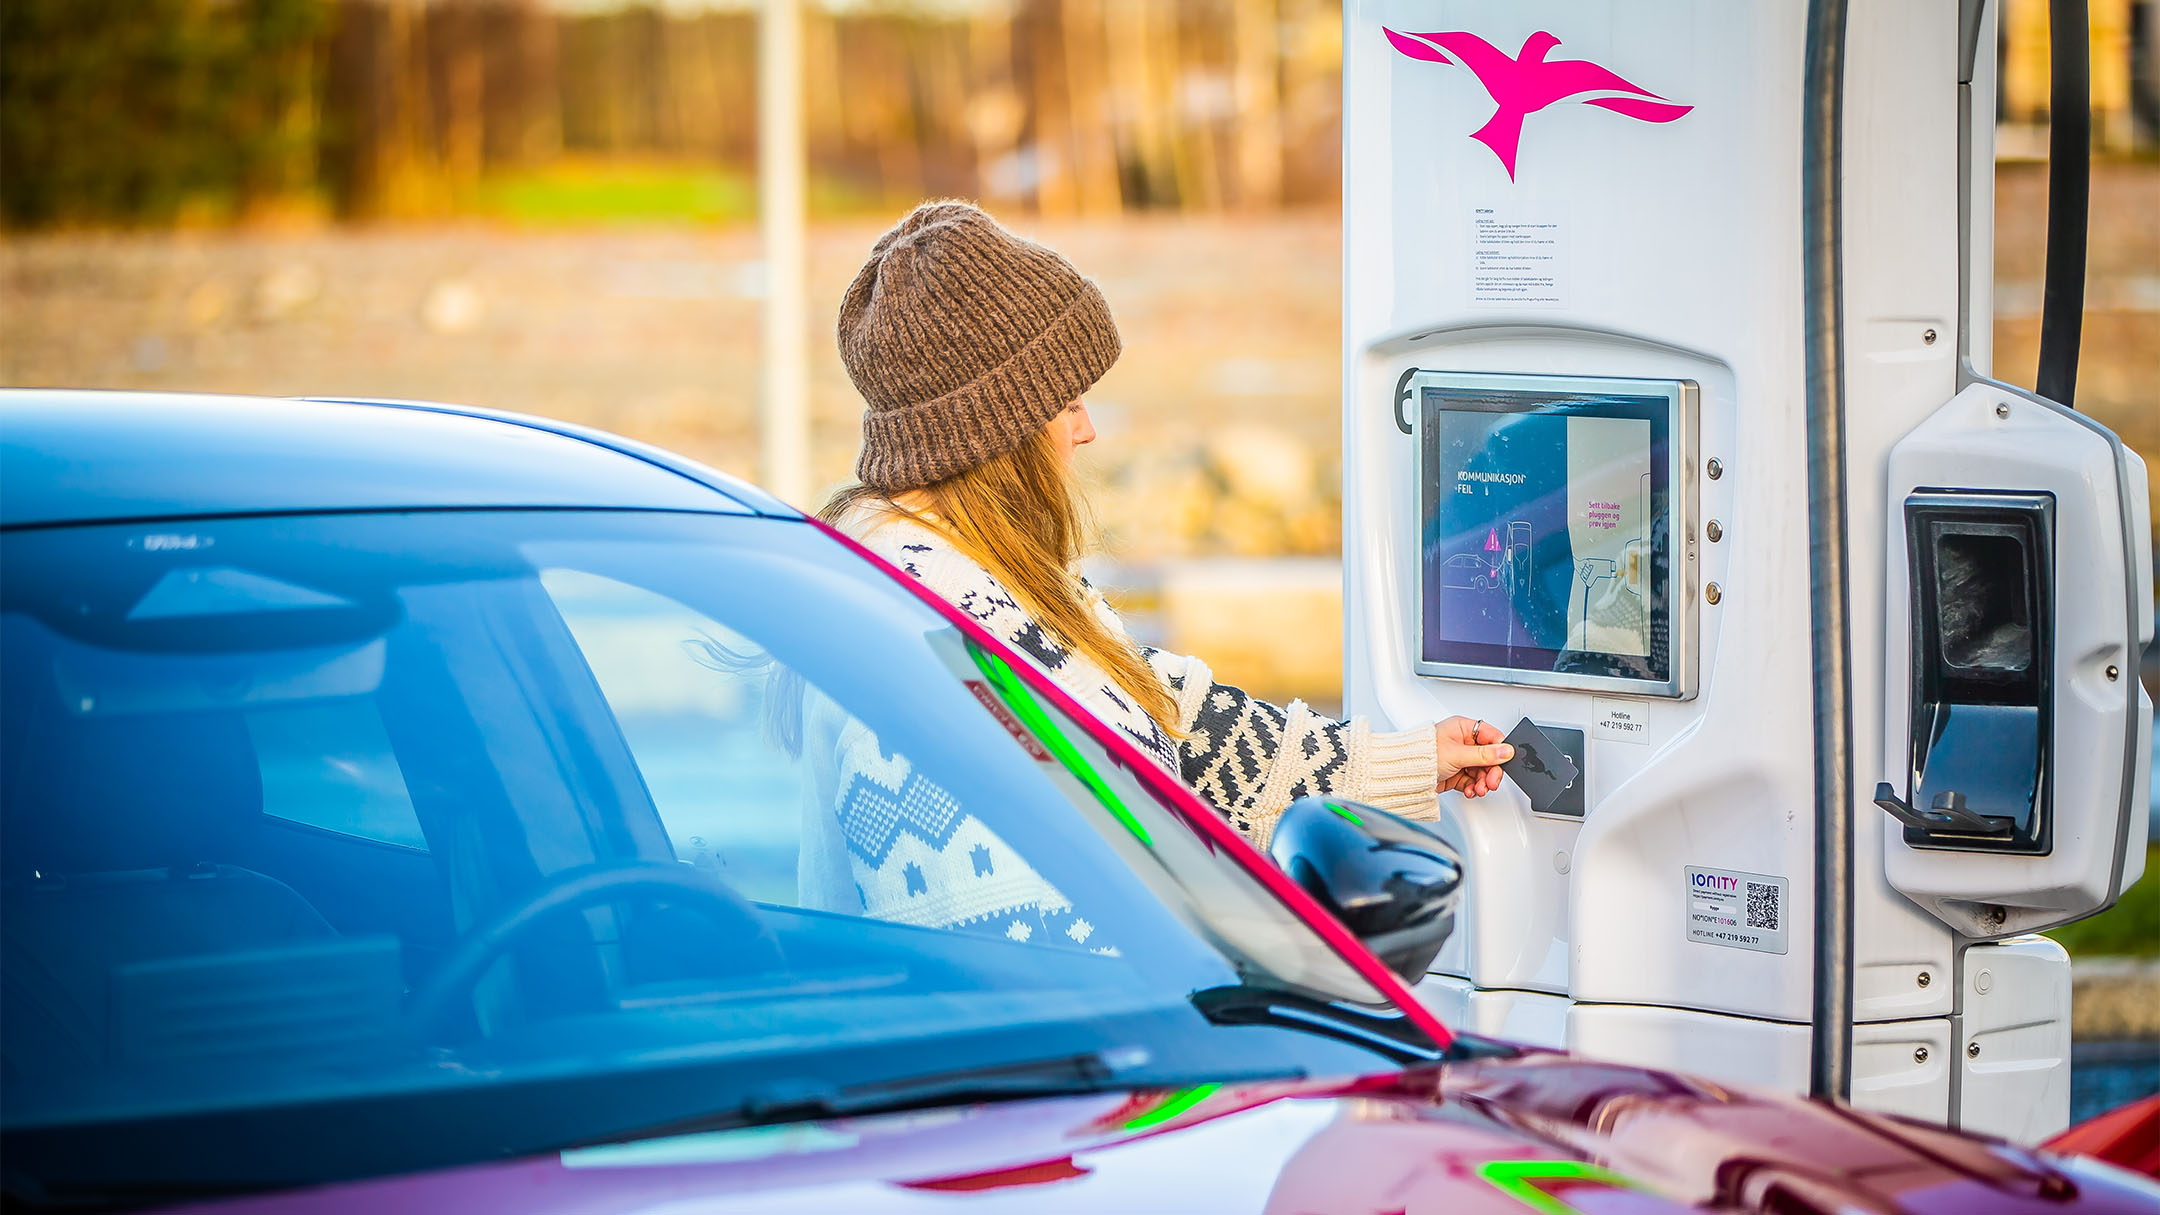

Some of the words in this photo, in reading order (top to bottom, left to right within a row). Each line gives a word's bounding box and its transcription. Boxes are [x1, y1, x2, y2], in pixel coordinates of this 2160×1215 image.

[1457, 471, 1525, 485] KOMMUNIKASJON
[1457, 483, 1474, 495] FEIL
[1601, 502, 1620, 510] tilbake
[1588, 510, 1611, 520] pluggen
[1611, 711, 1630, 720] Hotline
[1611, 721, 1622, 730] 219
[1623, 722, 1634, 731] 592
[1635, 724, 1642, 732] 77
[1691, 872, 1738, 890] IONITY
[1692, 929, 1714, 939] HOTLINE
[1715, 932, 1726, 940] +47
[1727, 933, 1739, 942] 219
[1739, 934, 1751, 944] 592
[1751, 936, 1759, 945] 77
